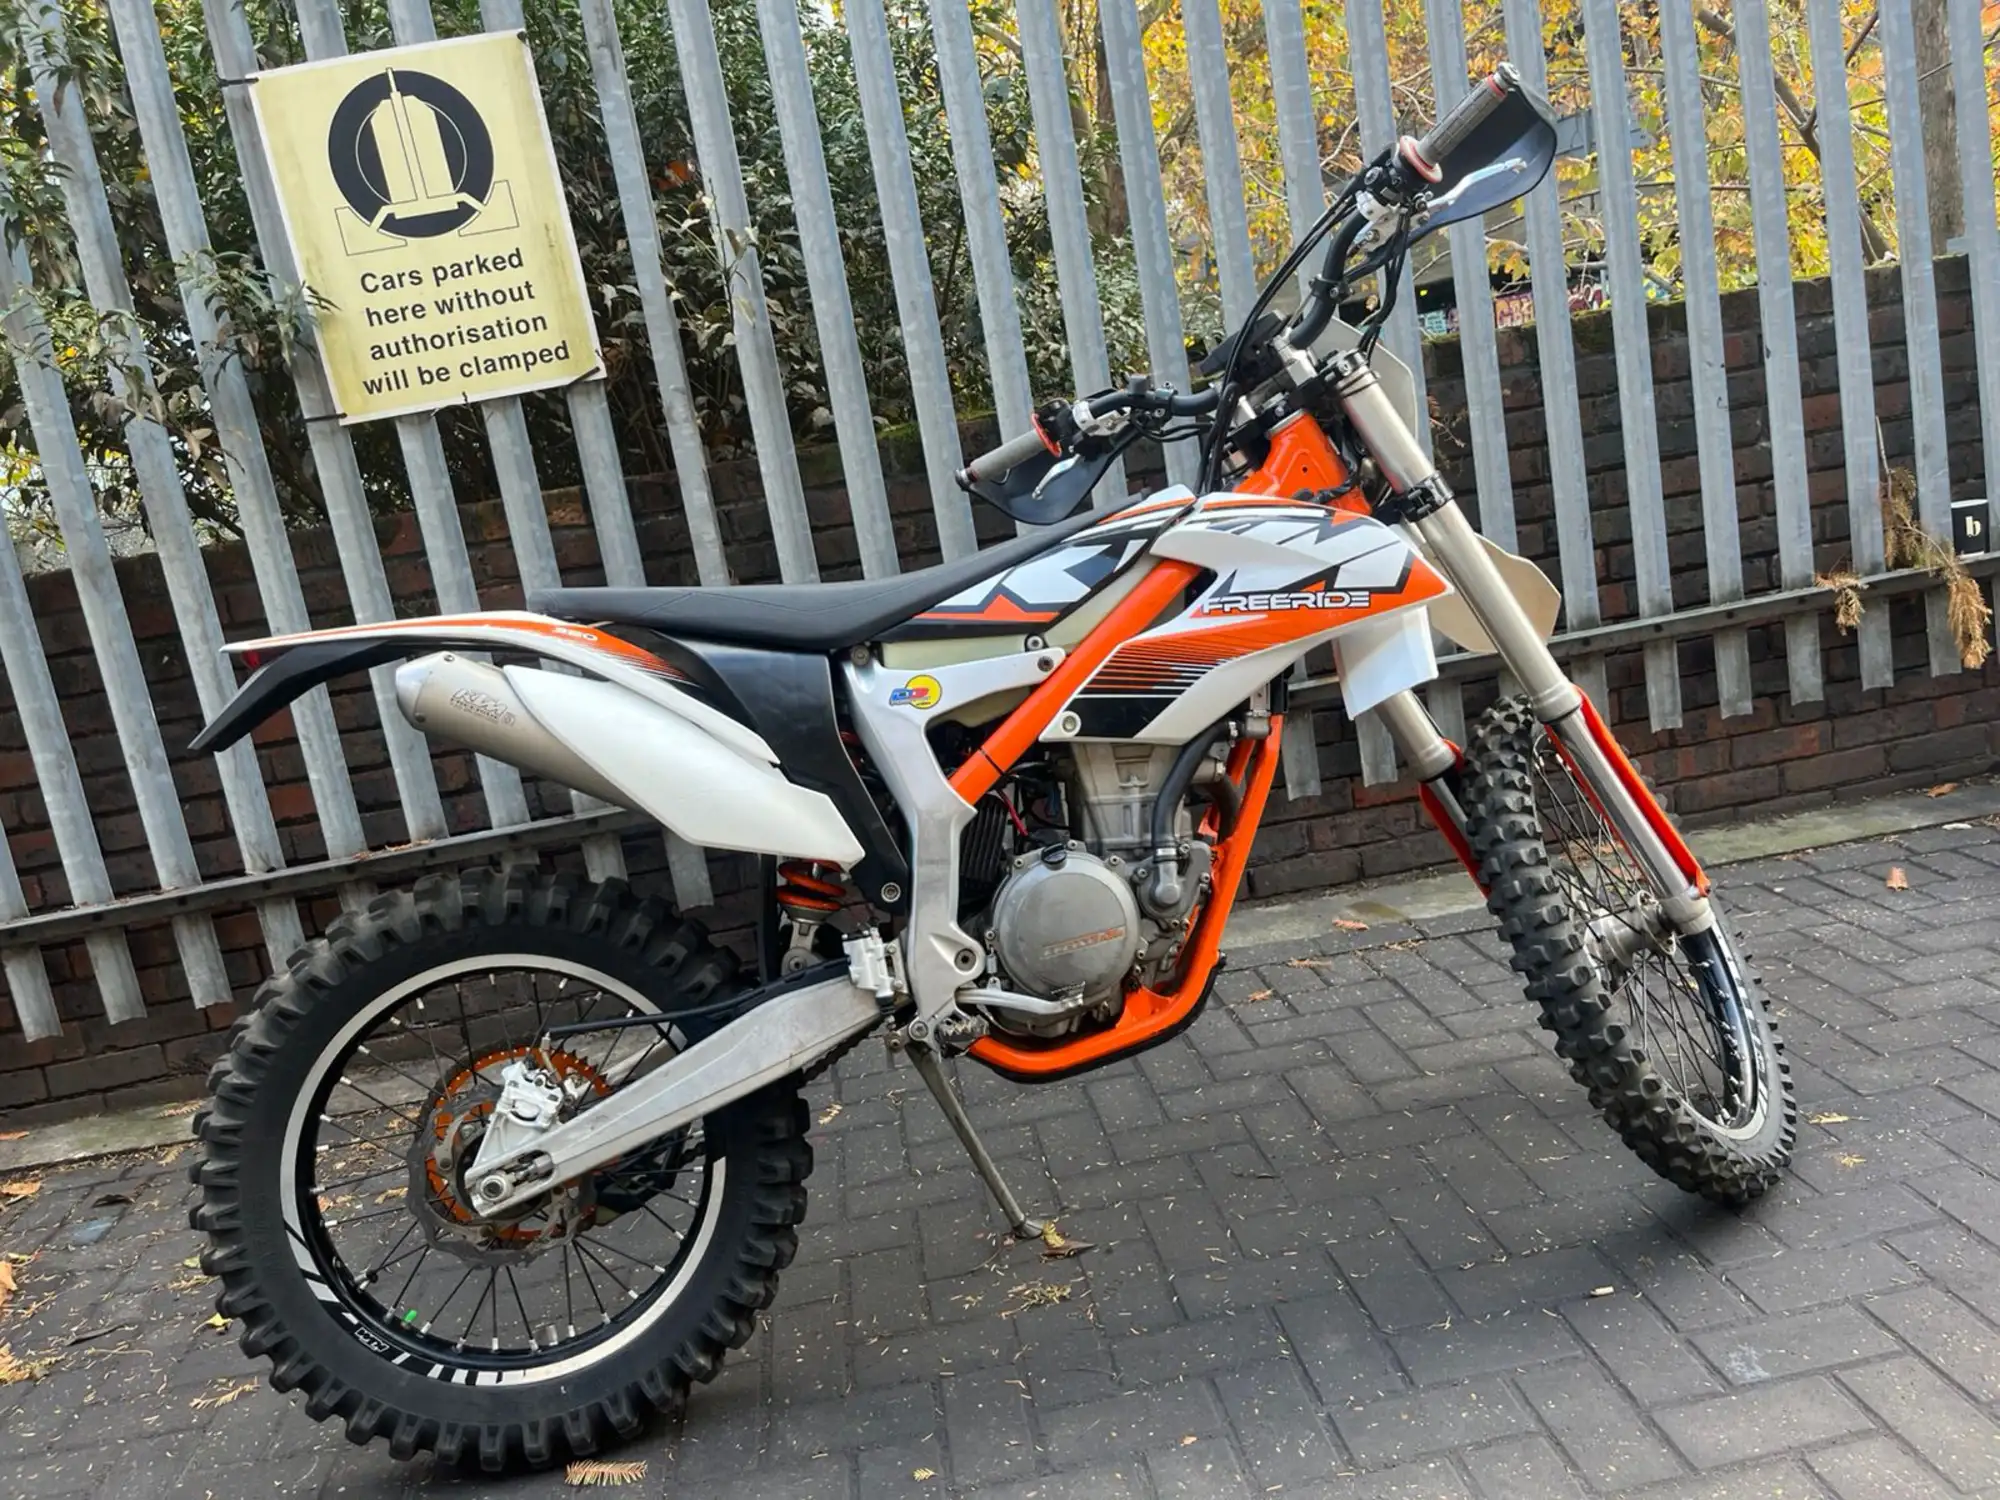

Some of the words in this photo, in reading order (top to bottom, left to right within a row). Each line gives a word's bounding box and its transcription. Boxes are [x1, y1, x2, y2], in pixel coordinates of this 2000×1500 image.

[360, 269, 423, 294] Cars
[432, 247, 524, 287] parked
[365, 302, 426, 327] here
[434, 280, 535, 315] without
[369, 315, 548, 361] authorisation
[362, 369, 409, 395] will
[417, 365, 450, 386] be
[459, 340, 570, 374] clamped
[1965, 515, 1981, 538] b
[1202, 590, 1370, 614] FREERIDE
